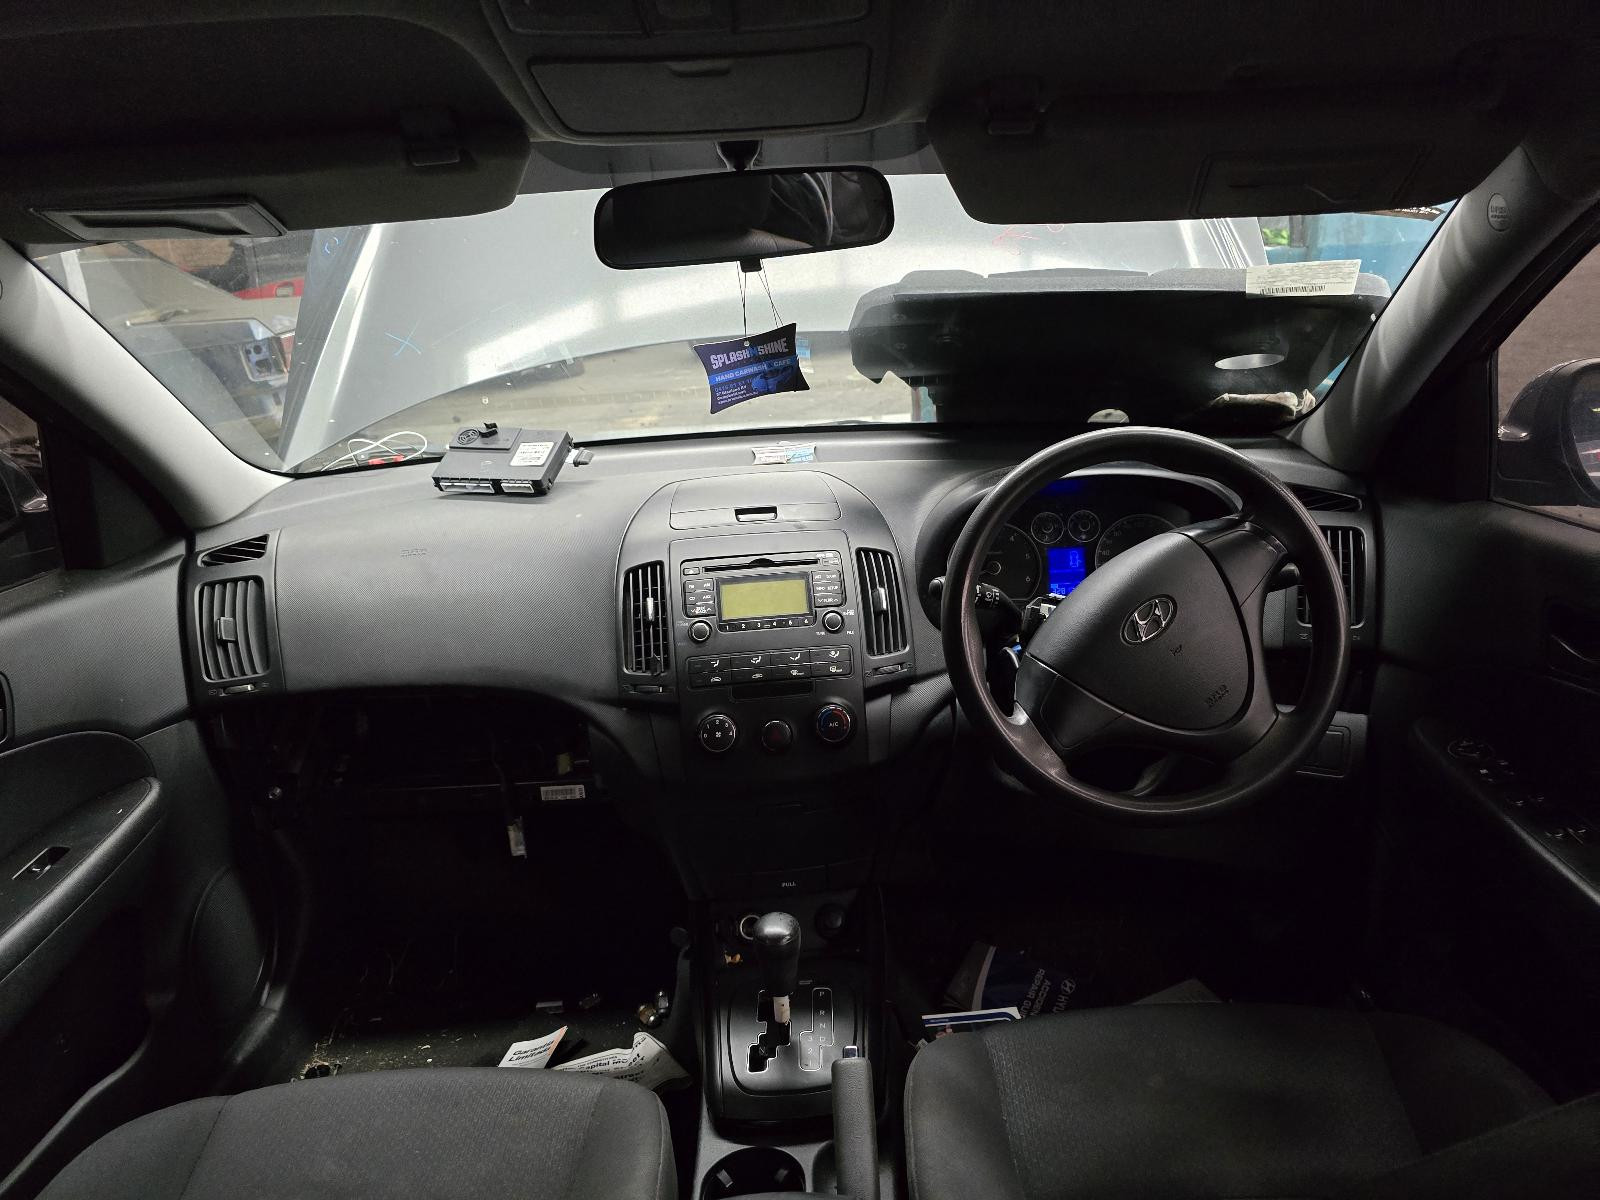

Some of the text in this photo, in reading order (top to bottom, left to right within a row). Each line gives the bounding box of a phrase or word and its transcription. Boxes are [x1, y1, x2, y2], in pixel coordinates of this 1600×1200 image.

[709, 349, 750, 370] SPLASH
[758, 338, 789, 355] SHINE
[715, 373, 735, 382] HAND
[735, 363, 767, 377] CARWASH
[773, 359, 790, 367] CAFE
[829, 720, 839, 728] A/C
[1026, 968, 1046, 999] REPAIR
